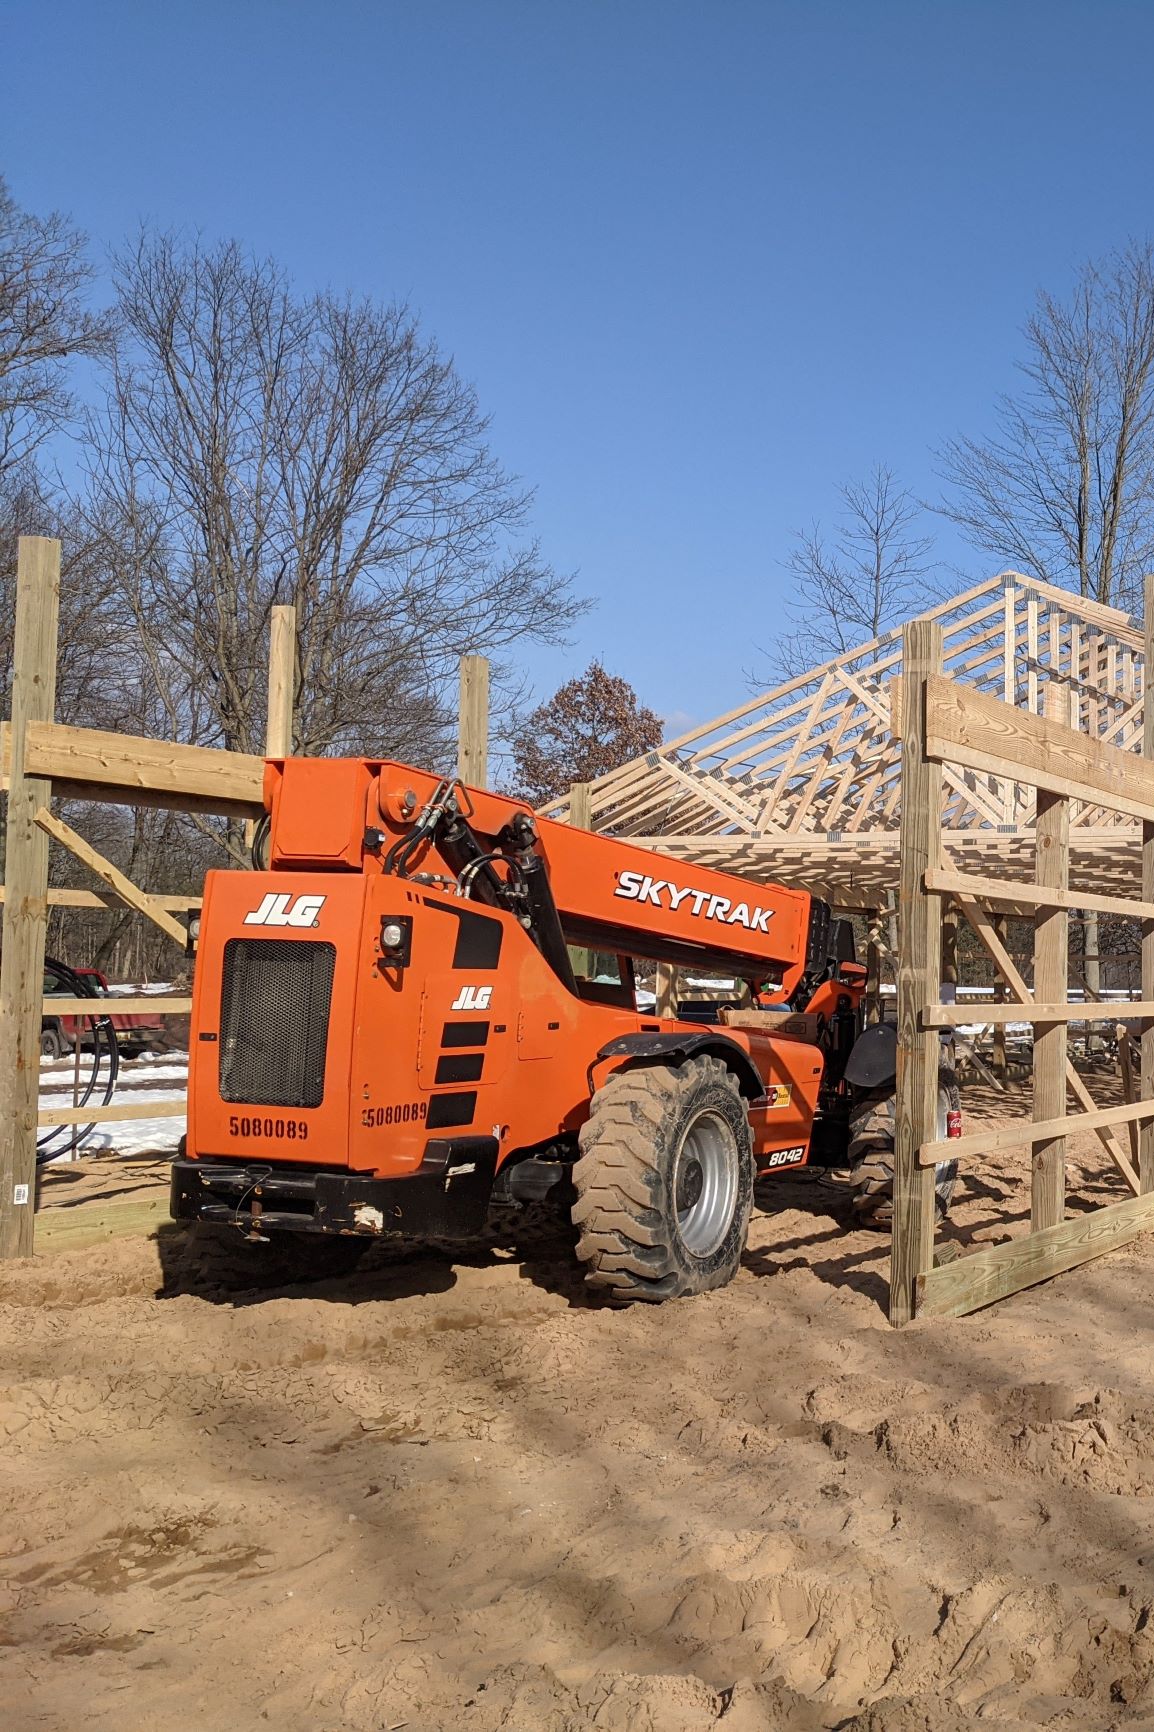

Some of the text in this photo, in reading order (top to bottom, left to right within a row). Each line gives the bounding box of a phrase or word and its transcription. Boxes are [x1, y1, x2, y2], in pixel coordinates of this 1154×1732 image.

[243, 892, 327, 928] JLG
[614, 871, 775, 934] SKYTRAK
[450, 985, 494, 1010] JLG
[367, 1102, 427, 1128] 5080089
[229, 1116, 308, 1140] 5080089
[769, 1148, 803, 1166] 8042
